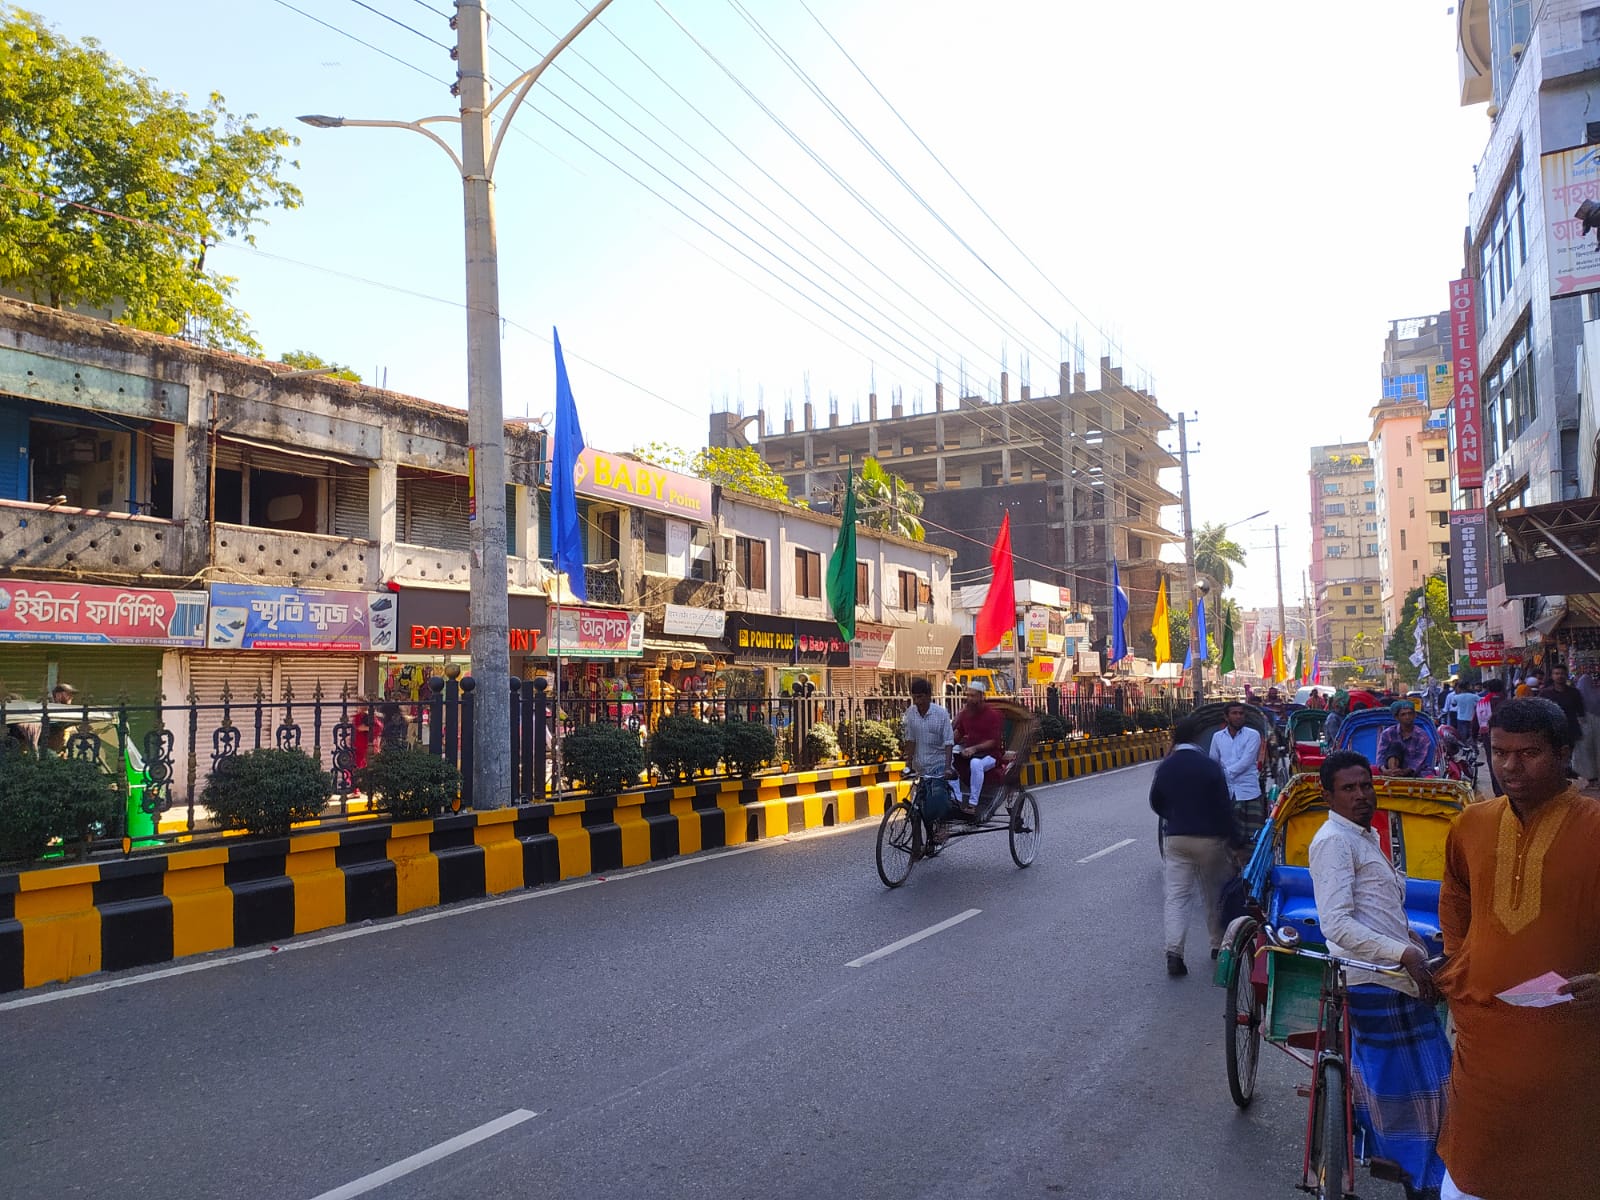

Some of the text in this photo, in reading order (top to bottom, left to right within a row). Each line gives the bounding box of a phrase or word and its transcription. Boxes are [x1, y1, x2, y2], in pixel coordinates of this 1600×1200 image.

[1453, 282, 1471, 350] HOTEL
[1458, 357, 1477, 462] SHAHJAHN
[593, 456, 702, 511] BABY Point
[1461, 526, 1478, 575] CHICKEN
[1464, 577, 1479, 598] HUT
[14, 589, 166, 632] ইষ্টার্ন ফার্ণিশিং
[250, 594, 305, 631] স্মৃতি
[308, 602, 349, 631] সুজ
[411, 625, 541, 651] BABY INT
[580, 616, 629, 646] অনুপম
[750, 630, 774, 649] POINT
[775, 632, 794, 650] PLUS
[808, 635, 829, 655] Baby
